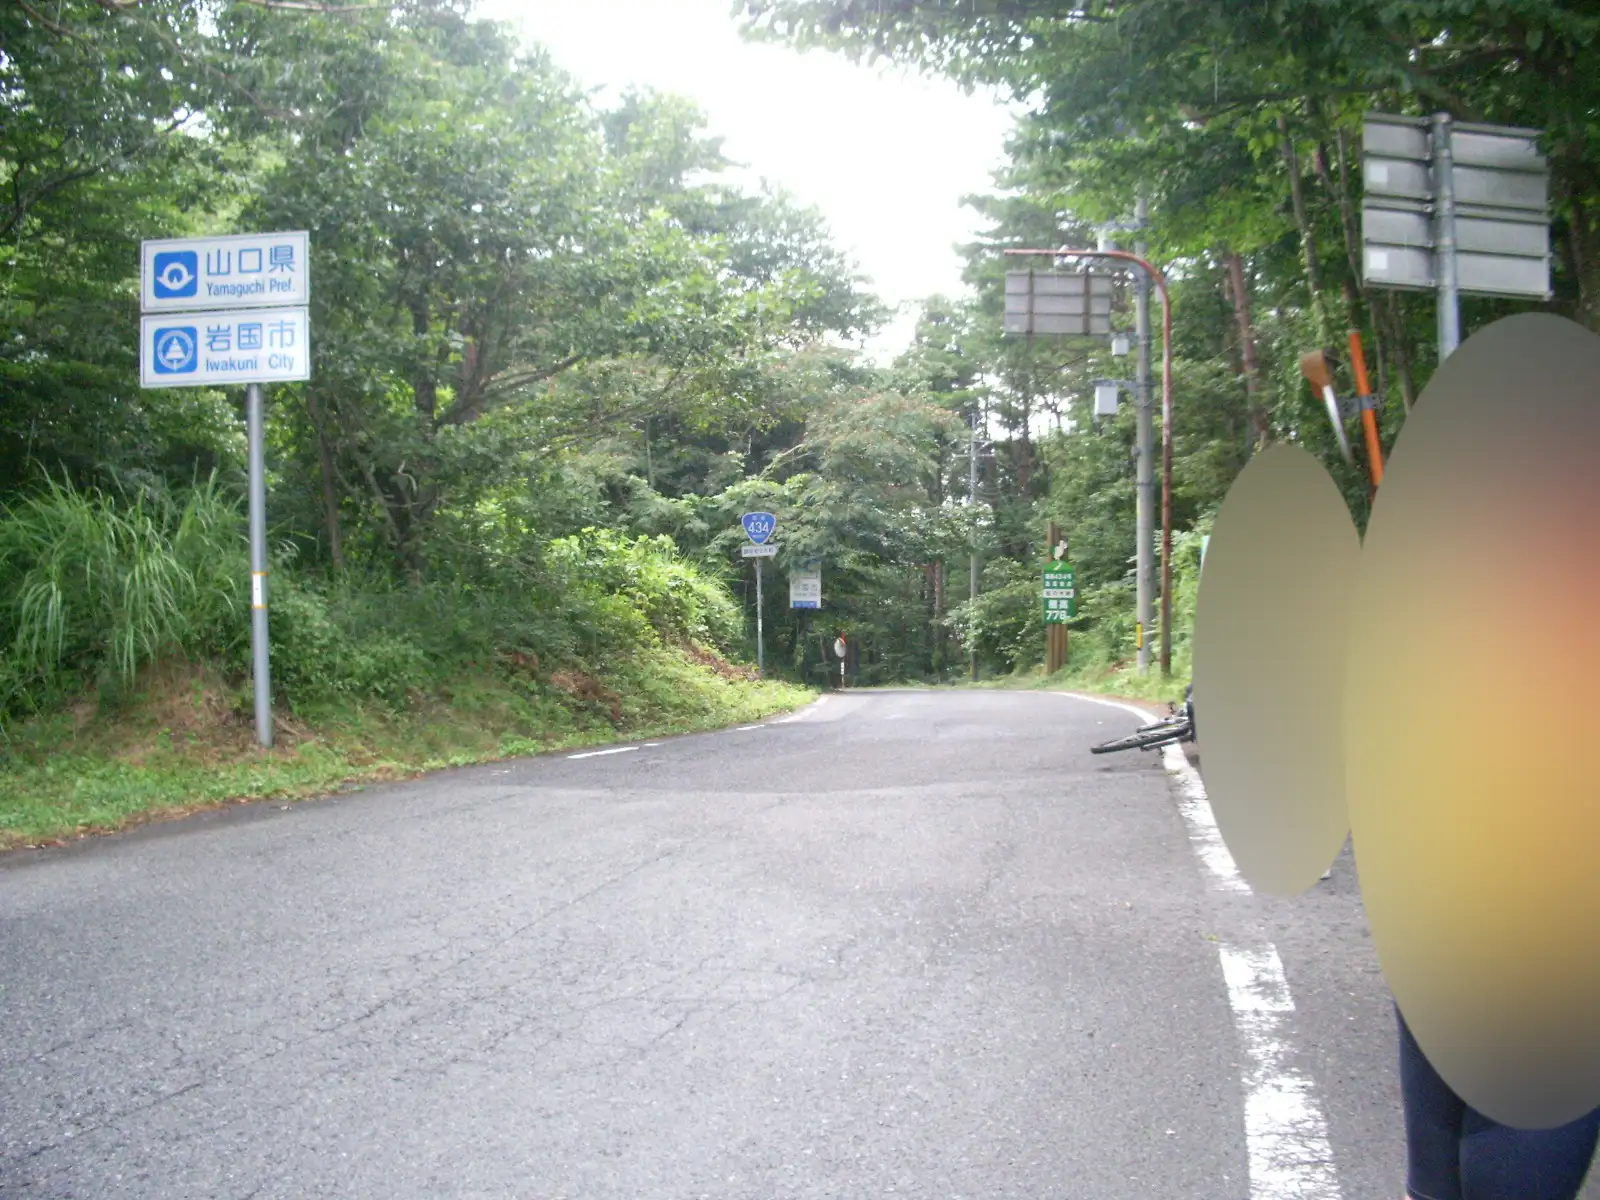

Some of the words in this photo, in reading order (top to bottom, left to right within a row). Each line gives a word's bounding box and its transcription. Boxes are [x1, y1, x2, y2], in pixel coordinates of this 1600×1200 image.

[207, 245, 296, 276] 山口県
[206, 280, 265, 298] Yamaguchi
[269, 277, 296, 293] Pref.
[206, 320, 296, 352] 岩国市
[206, 356, 258, 372] Iwakuni
[268, 353, 295, 372] City
[748, 521, 769, 533] 434
